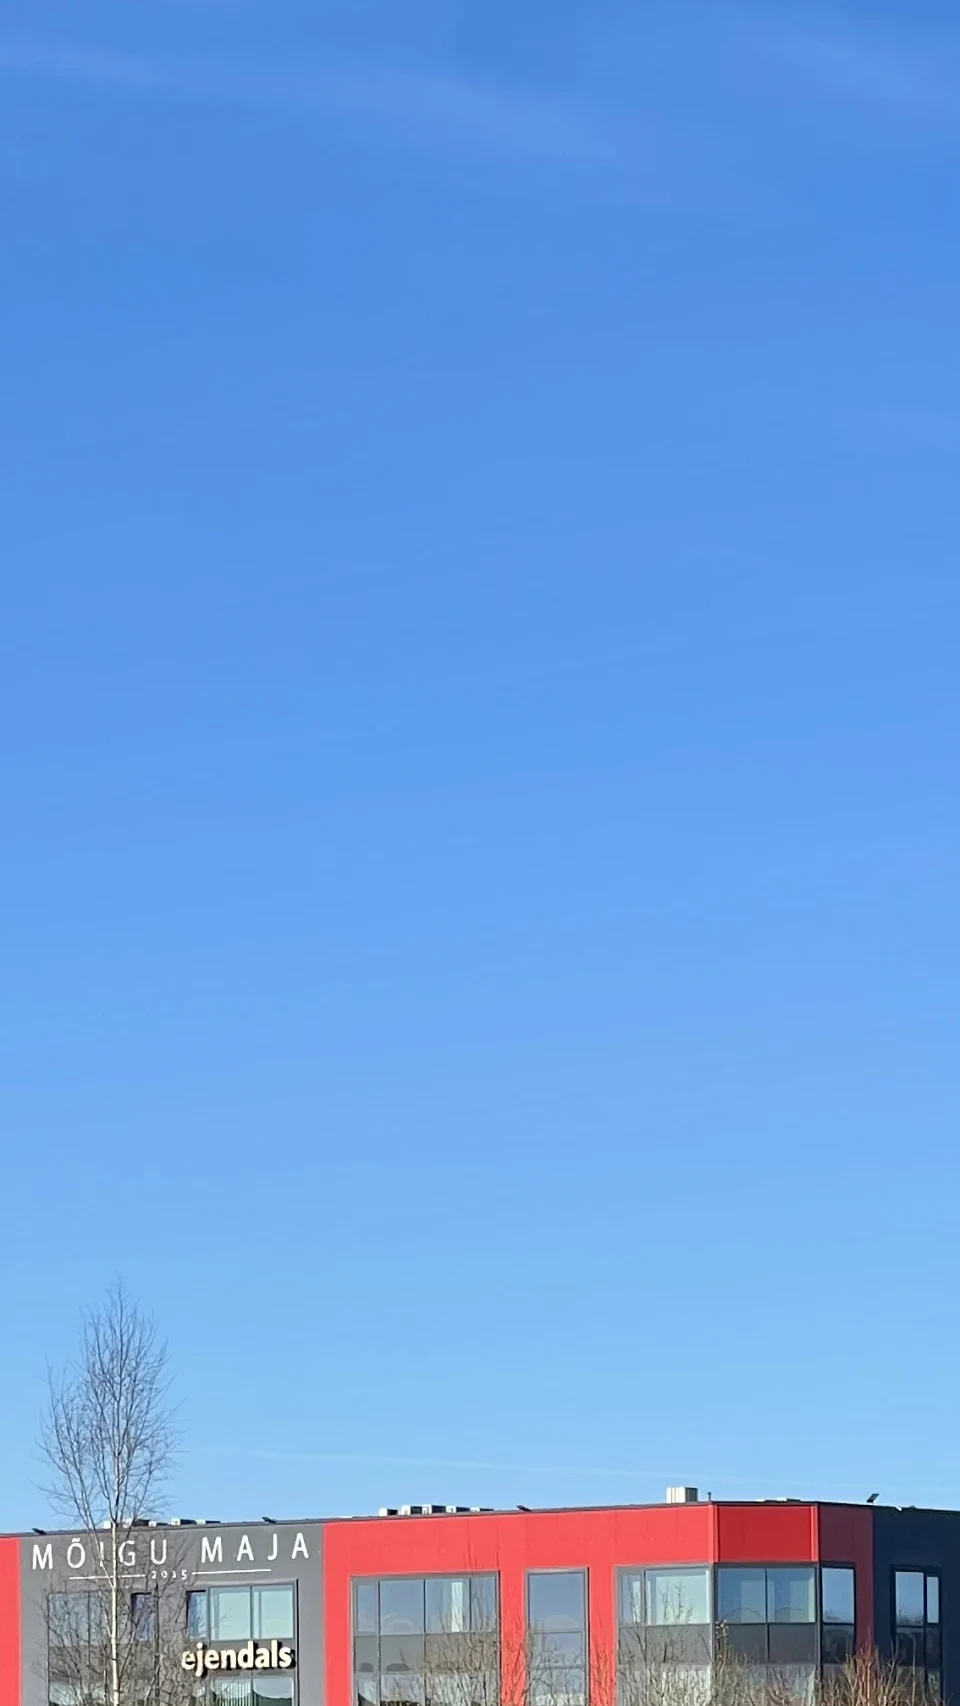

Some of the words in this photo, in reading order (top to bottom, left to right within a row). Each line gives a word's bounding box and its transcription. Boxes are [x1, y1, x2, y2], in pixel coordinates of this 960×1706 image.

[32, 1537, 167, 1570] MÕIGU
[201, 1533, 309, 1563] MAJA
[181, 1640, 293, 1677] ejendals
